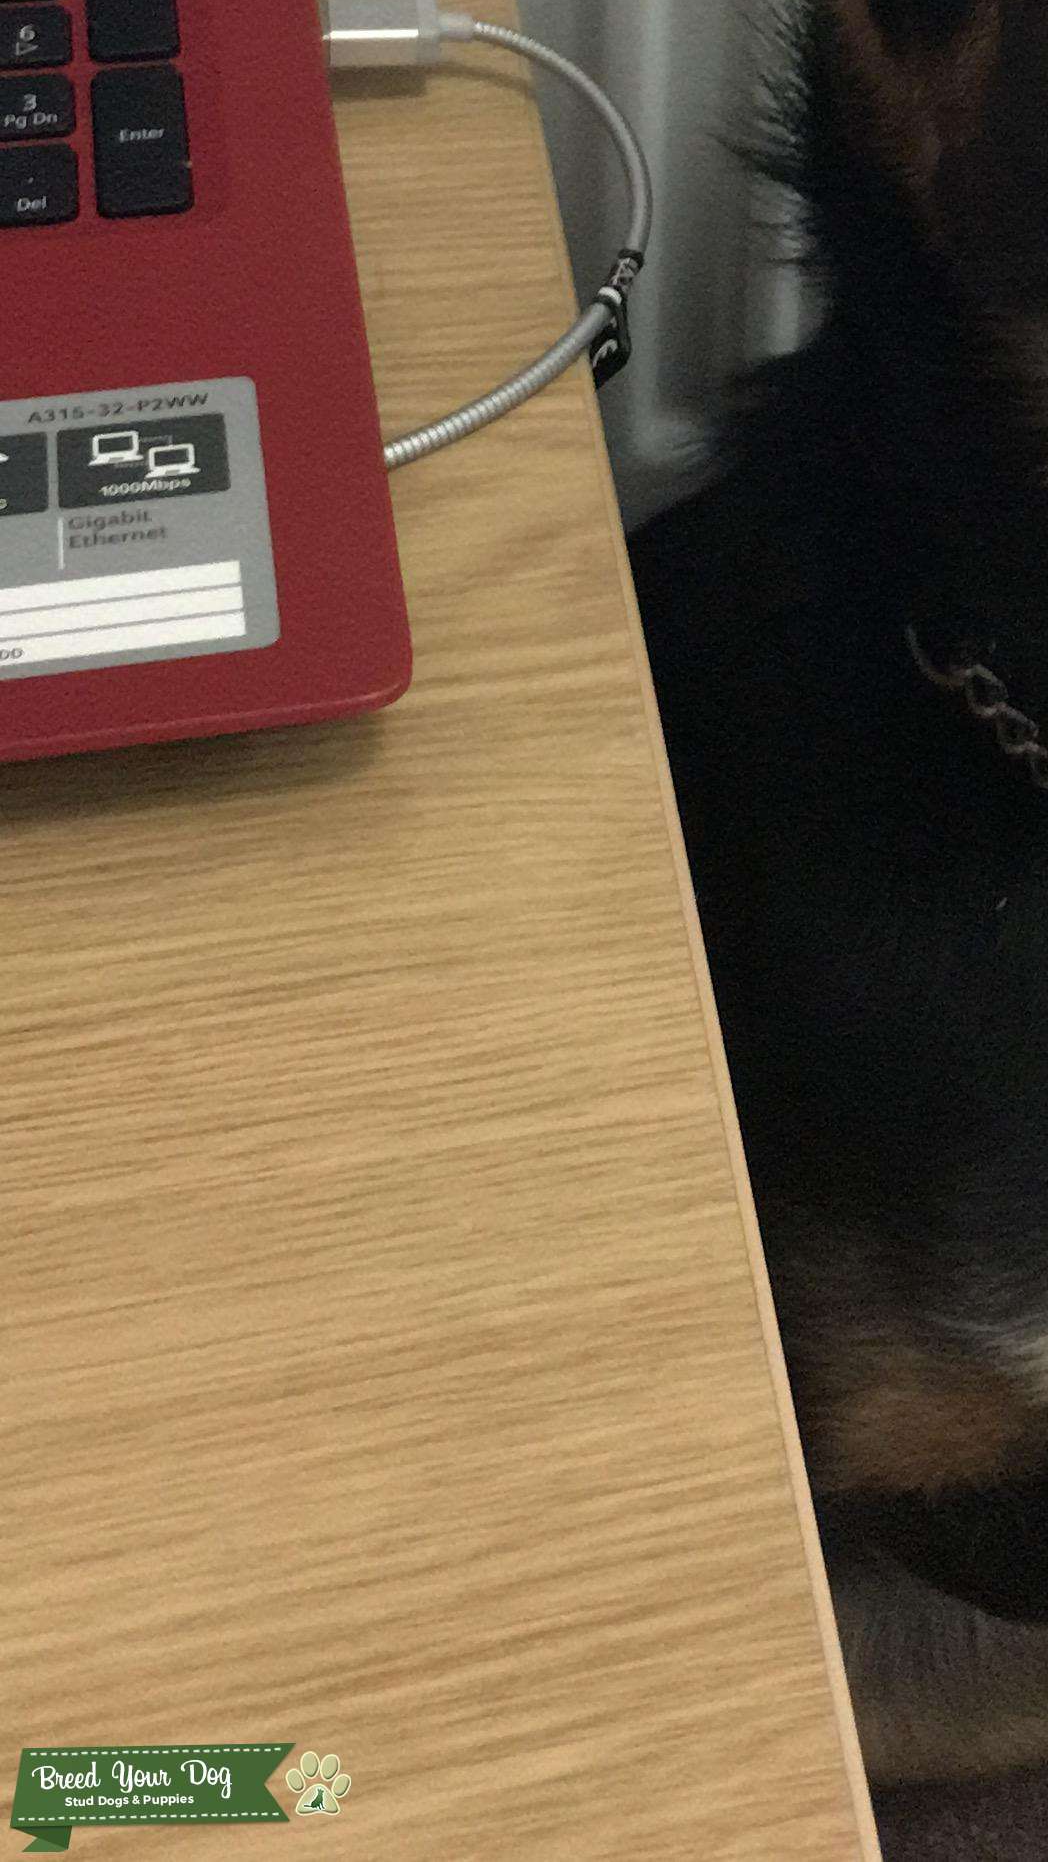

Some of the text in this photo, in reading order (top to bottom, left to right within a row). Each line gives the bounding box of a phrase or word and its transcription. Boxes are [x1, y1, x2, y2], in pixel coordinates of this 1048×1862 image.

[19, 25, 36, 42] 6
[22, 93, 37, 111] 3
[4, 111, 58, 129] Pg Dn
[119, 128, 165, 143] Enter
[16, 195, 47, 212] Del
[28, 393, 208, 423] A315-32-P2WW
[100, 478, 192, 497] 1000Mbps
[68, 509, 152, 532] Gigabit
[68, 527, 166, 549] Ethernet
